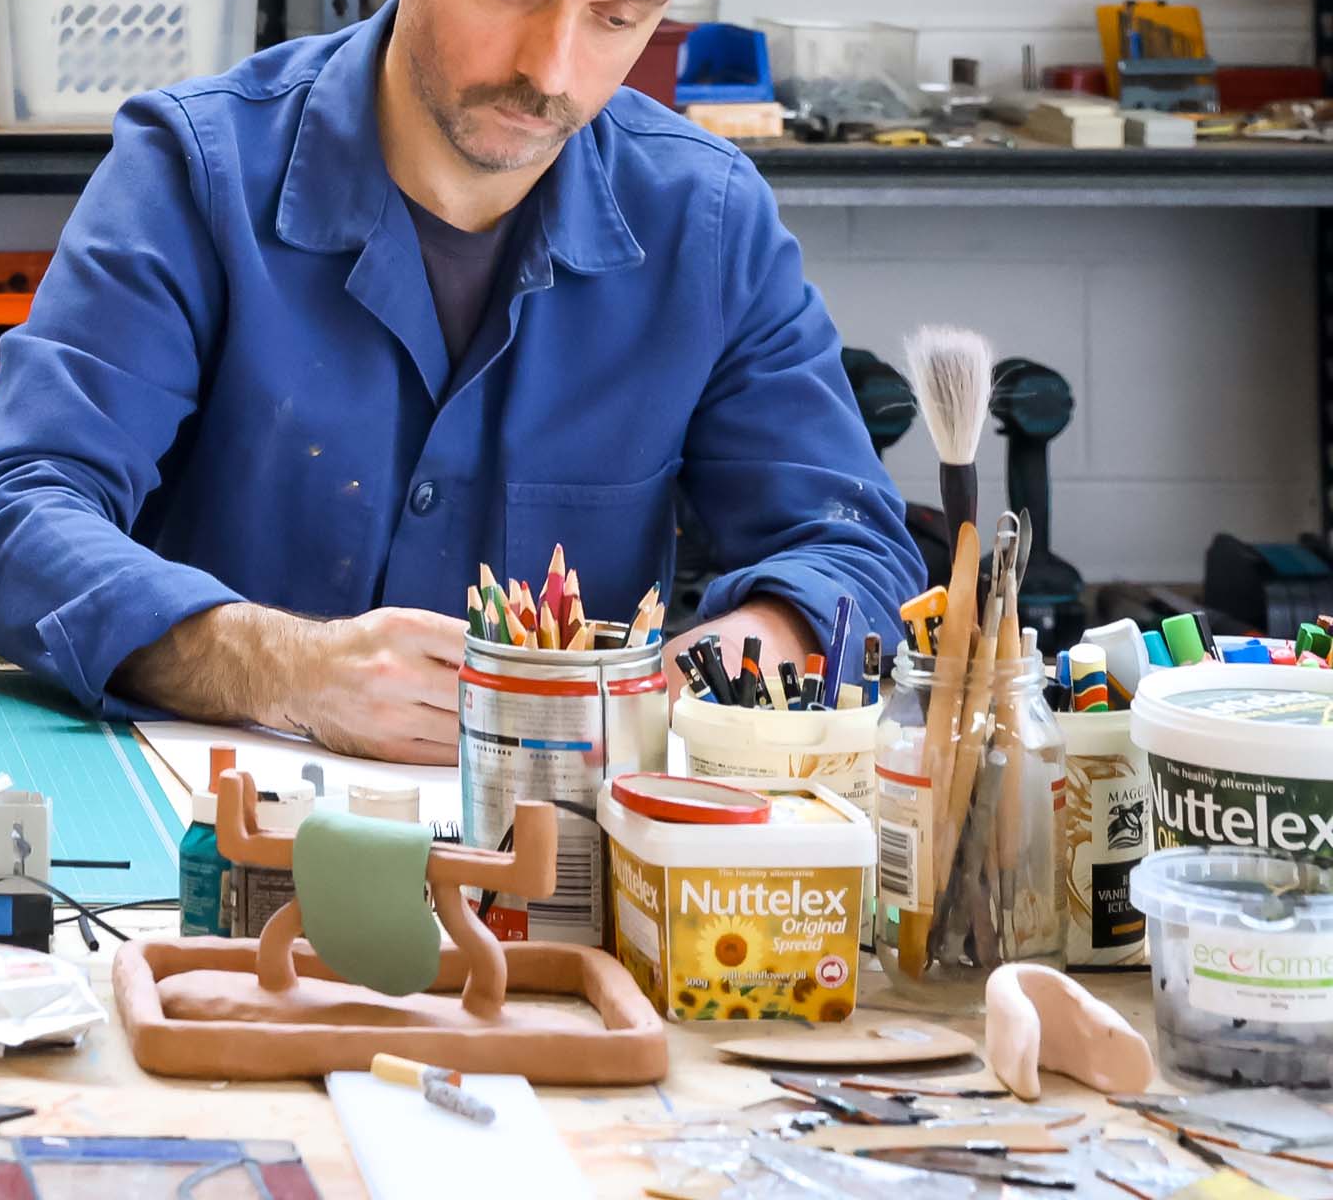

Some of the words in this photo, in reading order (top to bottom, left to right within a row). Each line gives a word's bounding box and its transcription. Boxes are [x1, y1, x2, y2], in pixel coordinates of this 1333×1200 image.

[1166, 762, 1180, 777] The
[1181, 768, 1218, 788] healthy
[1220, 776, 1286, 795] alternative
[1149, 772, 1333, 851] Nuttelex
[735, 869, 767, 880] healthy
[769, 869, 815, 878] alternative
[679, 879, 847, 917] Nuttelex
[781, 917, 848, 939] Original
[772, 936, 824, 955] Spread
